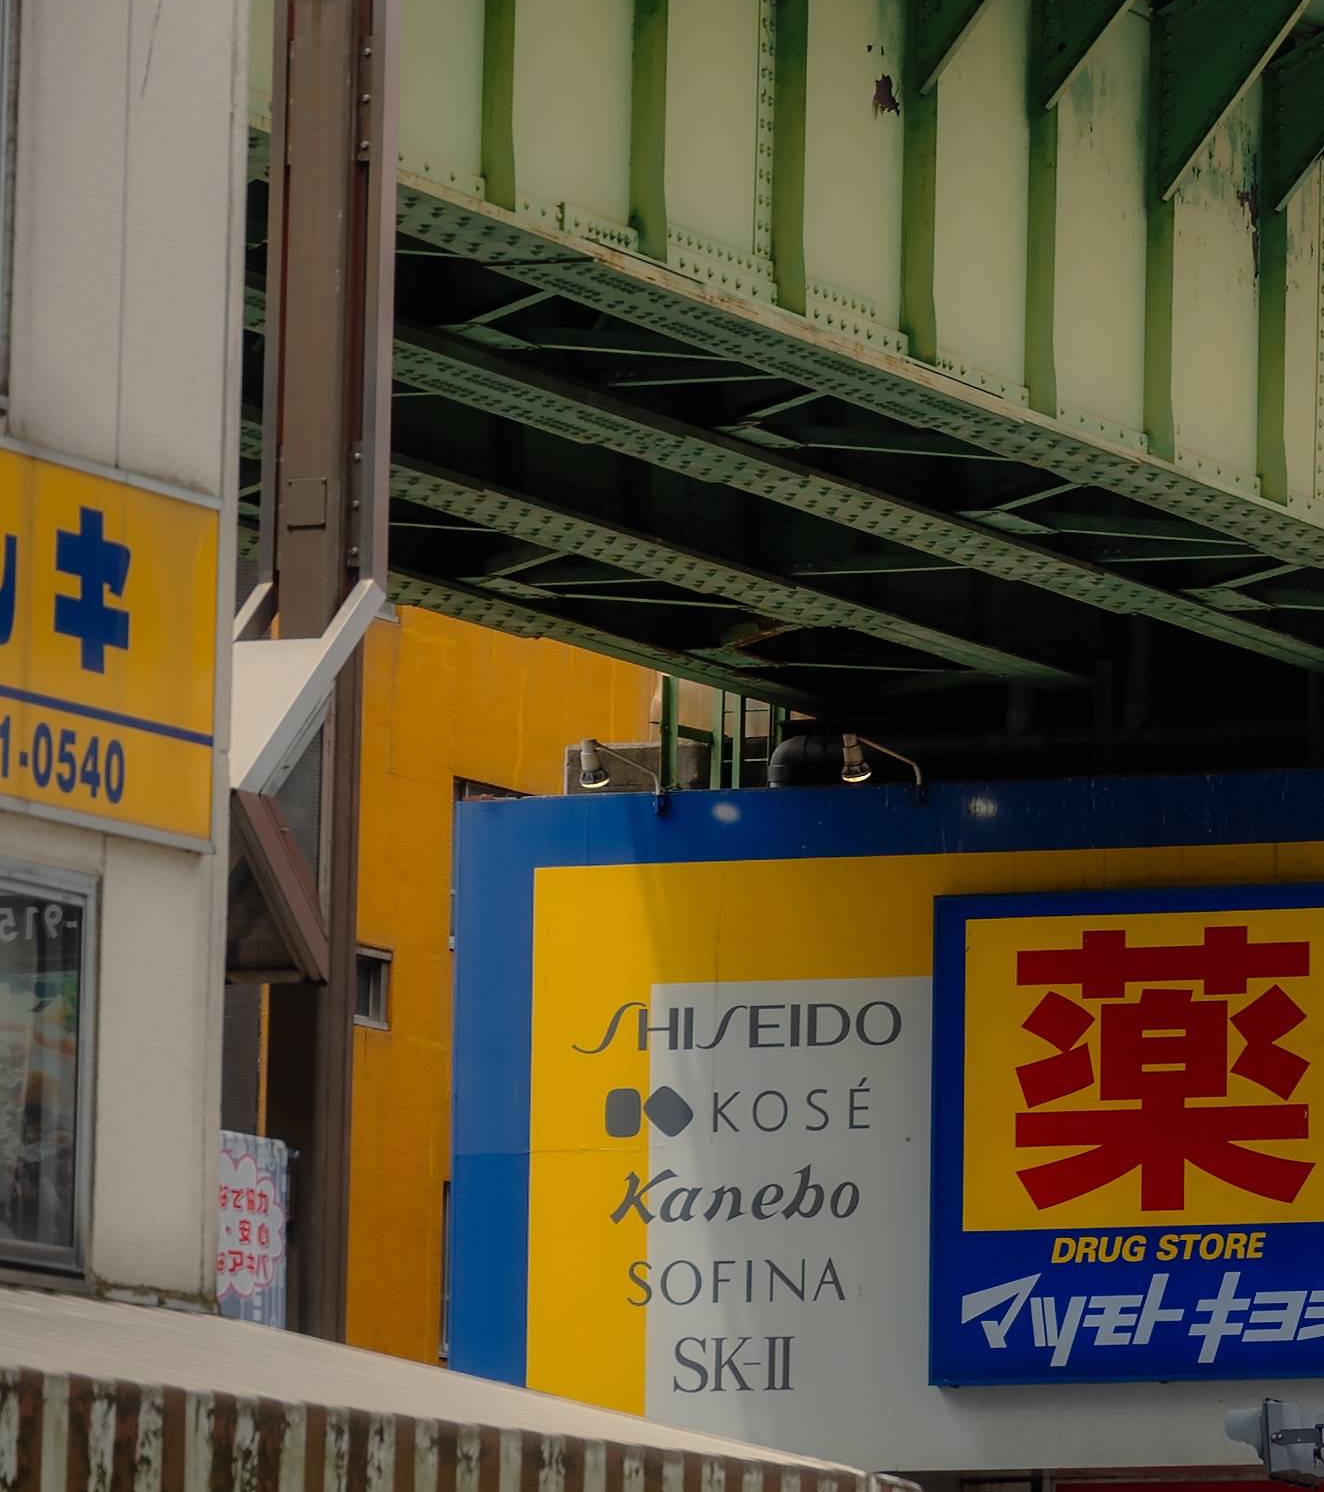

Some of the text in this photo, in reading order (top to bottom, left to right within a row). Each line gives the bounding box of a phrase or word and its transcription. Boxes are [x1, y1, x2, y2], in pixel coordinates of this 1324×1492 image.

[572, 1001, 902, 1054] SHISEIDO
[1015, 925, 1316, 1212] 薬
[713, 1077, 871, 1133] KOSÉ
[610, 1163, 860, 1224] Kanebo
[1051, 1232, 1266, 1264] DRUG STORE
[627, 1257, 846, 1307] SOFINA
[674, 1336, 796, 1393] SK-II
